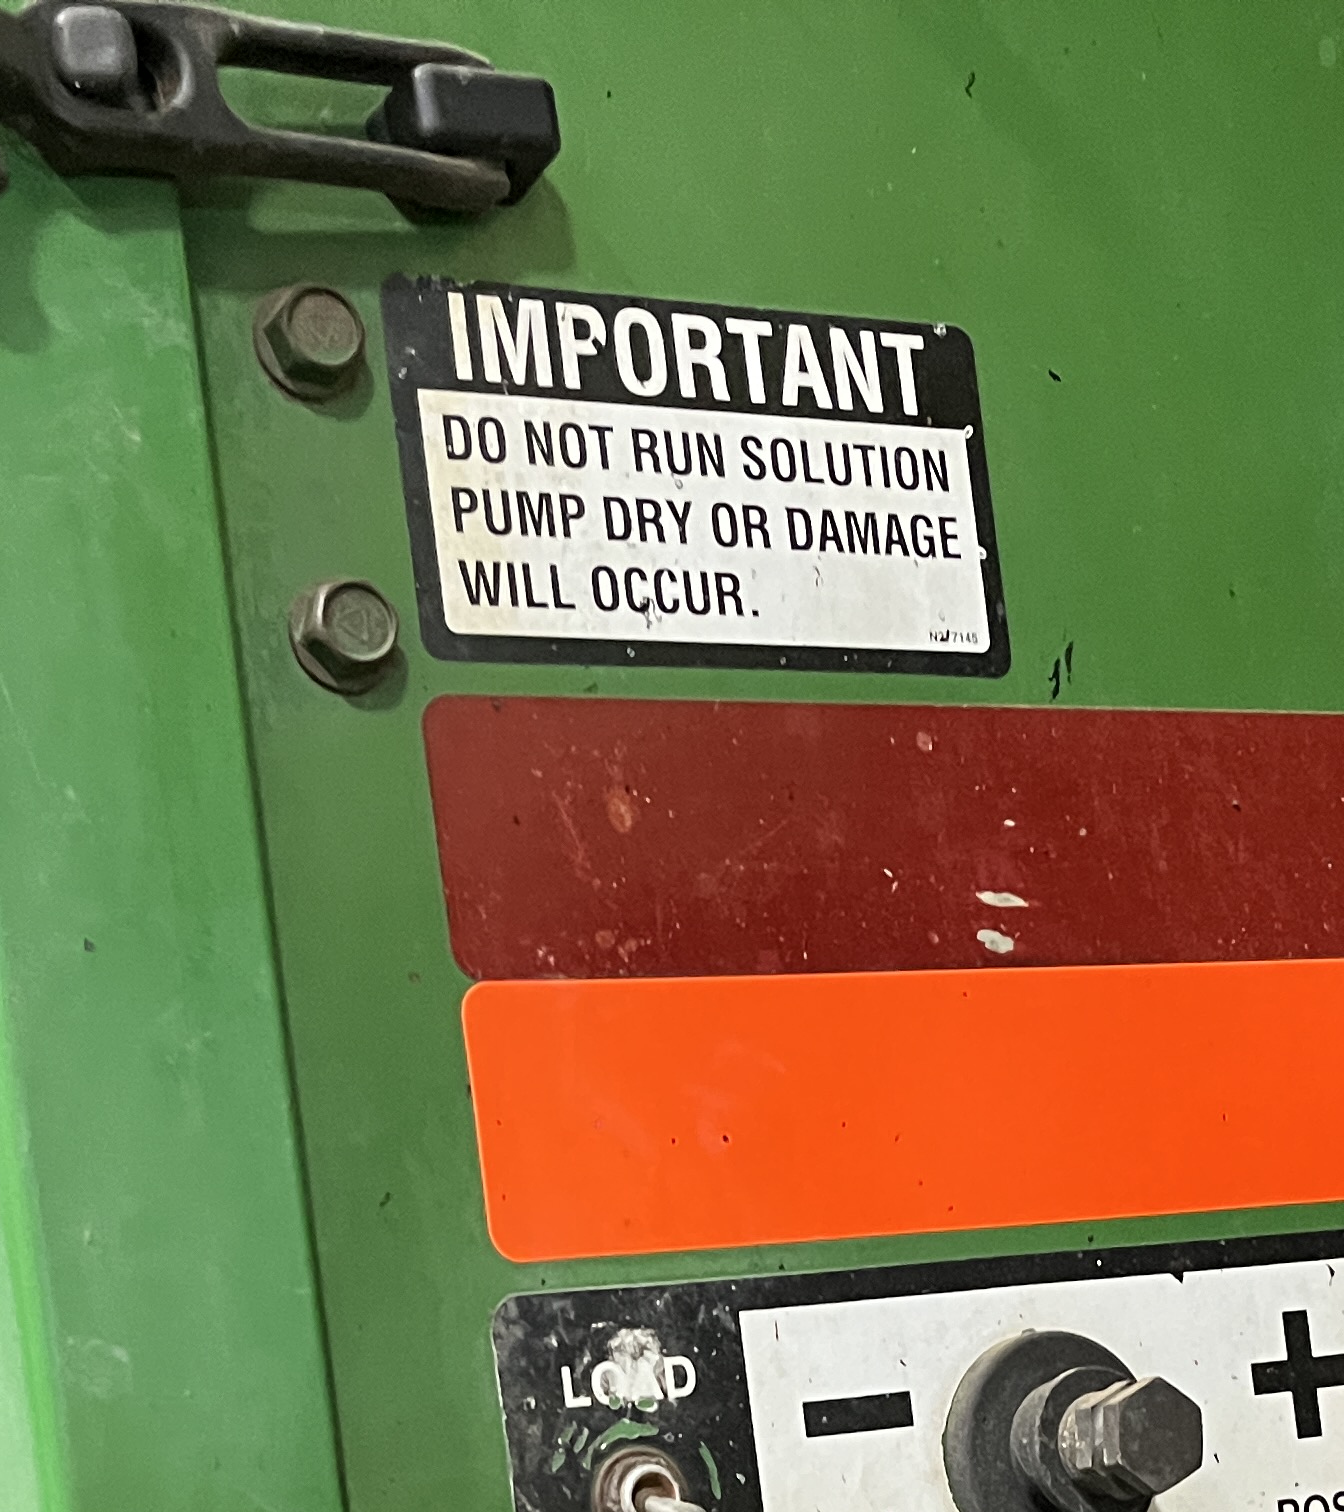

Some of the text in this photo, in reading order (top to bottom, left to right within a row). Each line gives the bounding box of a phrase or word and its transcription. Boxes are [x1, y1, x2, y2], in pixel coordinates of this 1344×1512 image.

[447, 292, 925, 416] IMPORTANT
[443, 414, 950, 492] DO NOT RUN SOLUTION
[451, 486, 962, 560] PUMP DRY OR DAMAGE
[459, 559, 760, 618] WILL OCCUR.
